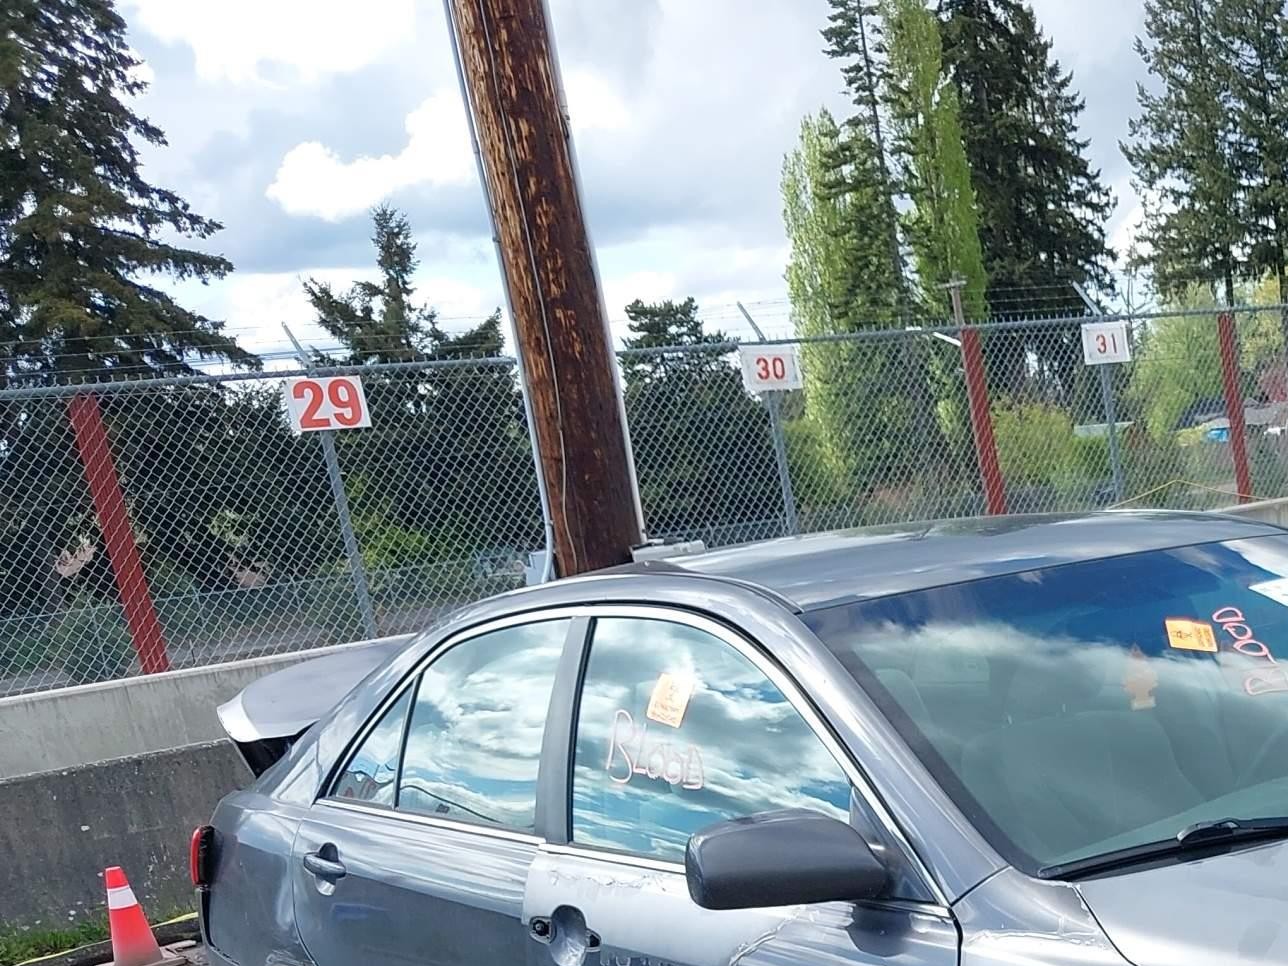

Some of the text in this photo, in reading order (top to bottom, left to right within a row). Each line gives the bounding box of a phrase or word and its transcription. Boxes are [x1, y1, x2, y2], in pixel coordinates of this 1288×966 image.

[1095, 333, 1118, 355] 31
[755, 356, 786, 380] 30
[292, 377, 363, 429] 29
